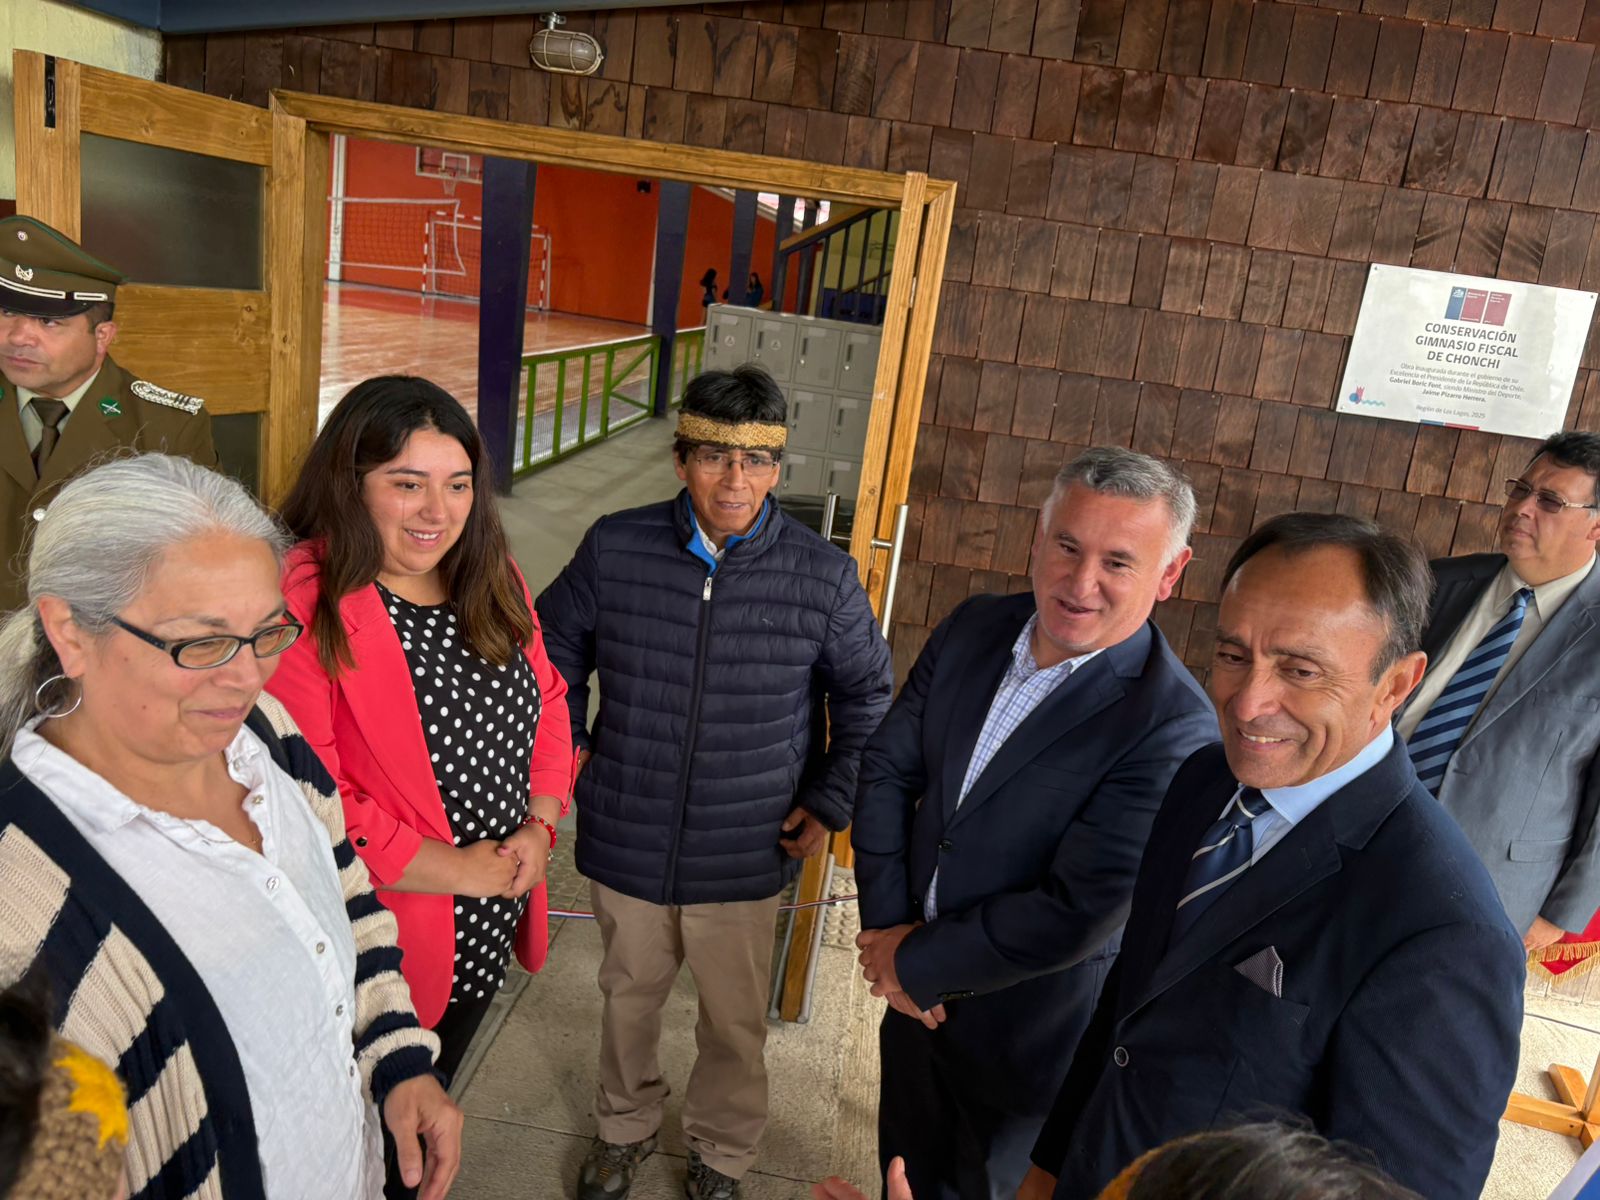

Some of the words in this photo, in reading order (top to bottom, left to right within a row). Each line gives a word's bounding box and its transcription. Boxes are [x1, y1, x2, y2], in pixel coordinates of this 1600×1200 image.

[1425, 322, 1516, 343] CONSERVACIÓN
[1416, 335, 1475, 352] GIMNASIO
[1478, 343, 1518, 358] FISCAL
[1427, 351, 1444, 361] DE
[1446, 353, 1500, 369] CHONCHI
[1389, 376, 1411, 384] Gabriel
[1412, 379, 1427, 387] Boric
[1441, 391, 1462, 399] Pizarro
